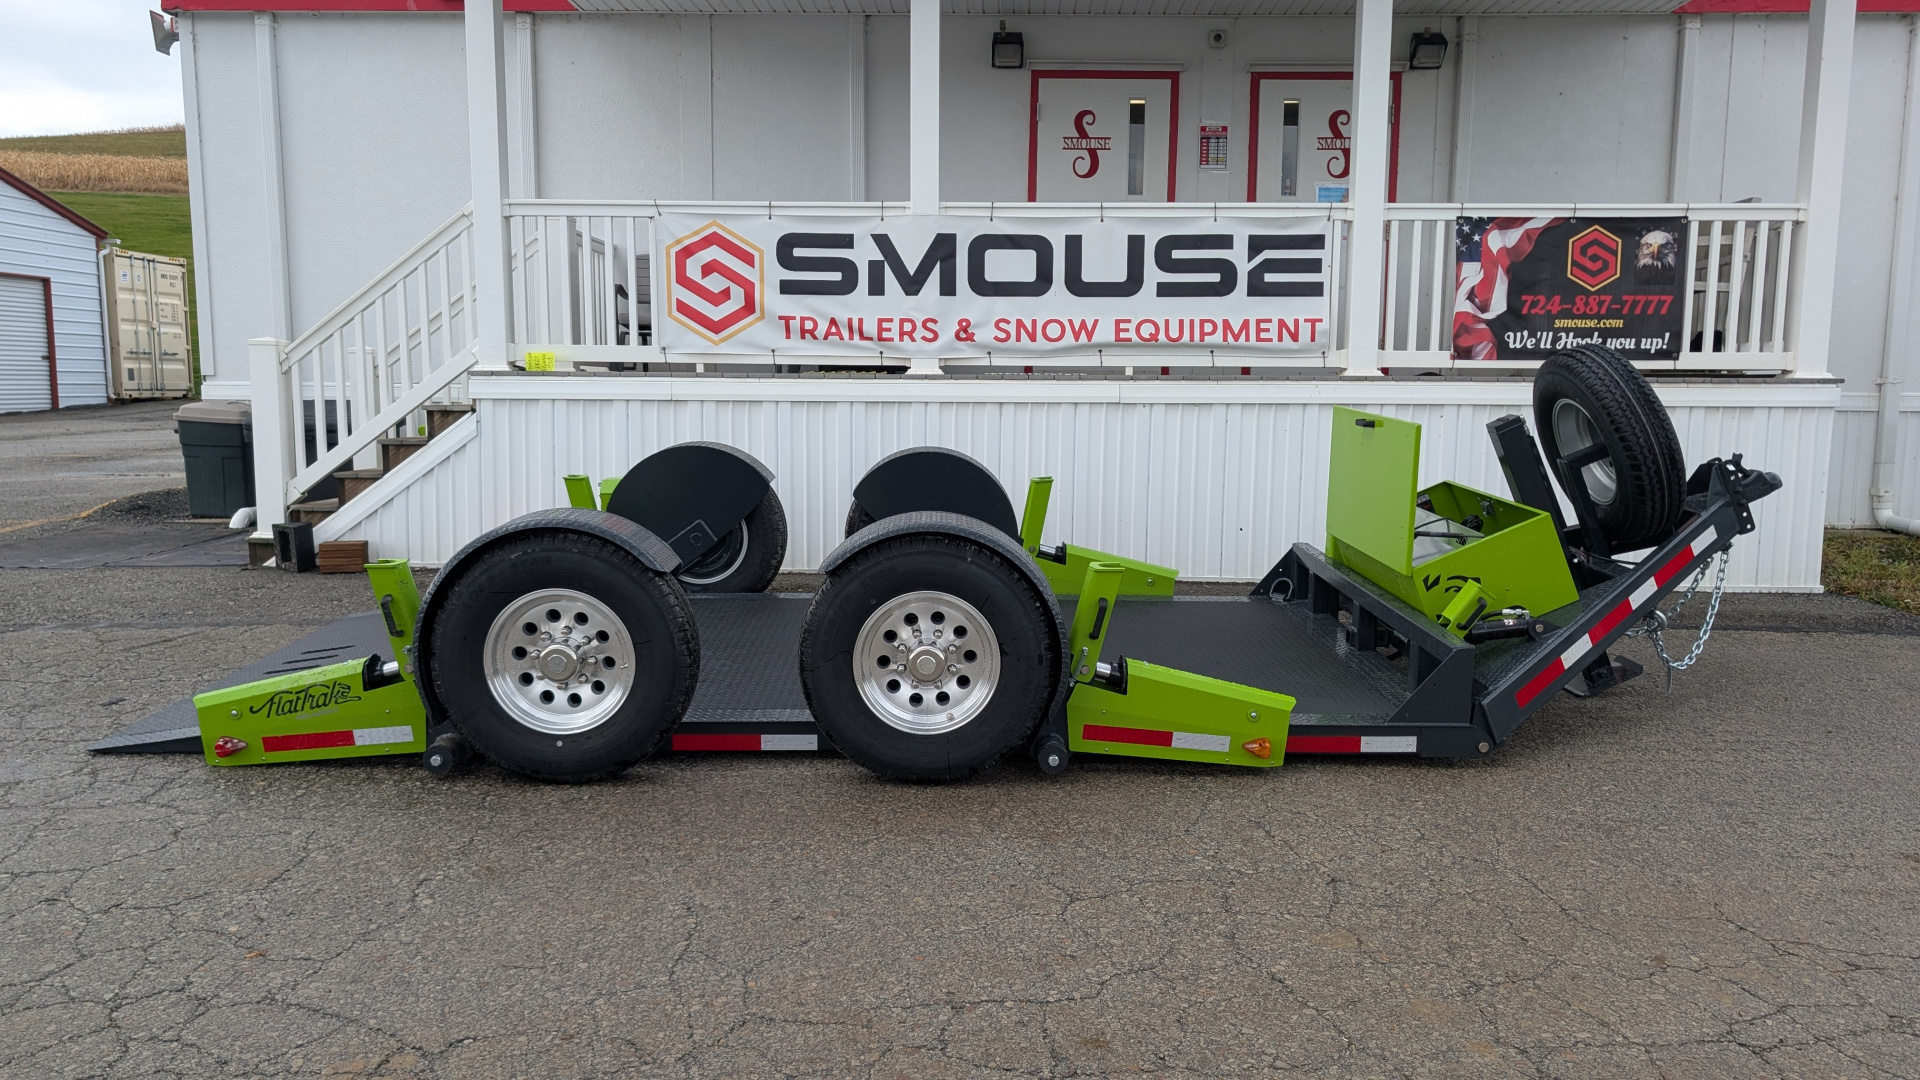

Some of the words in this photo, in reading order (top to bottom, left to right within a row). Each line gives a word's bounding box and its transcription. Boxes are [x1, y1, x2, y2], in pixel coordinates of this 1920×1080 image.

[1062, 137, 1111, 150] SMOUSE
[1316, 137, 1351, 150] SMOU
[775, 231, 1326, 298] SMOUSE
[1520, 293, 1674, 315] 724-887-7777
[777, 314, 940, 343] TRAILERS
[954, 317, 977, 343] &
[993, 317, 1102, 343] SNOW
[1114, 317, 1325, 344] EQUIPMENT
[1553, 318, 1624, 328] smouse.com
[1504, 330, 1554, 349] We'll
[1605, 336, 1636, 350] you
[1640, 332, 1671, 354] up!
